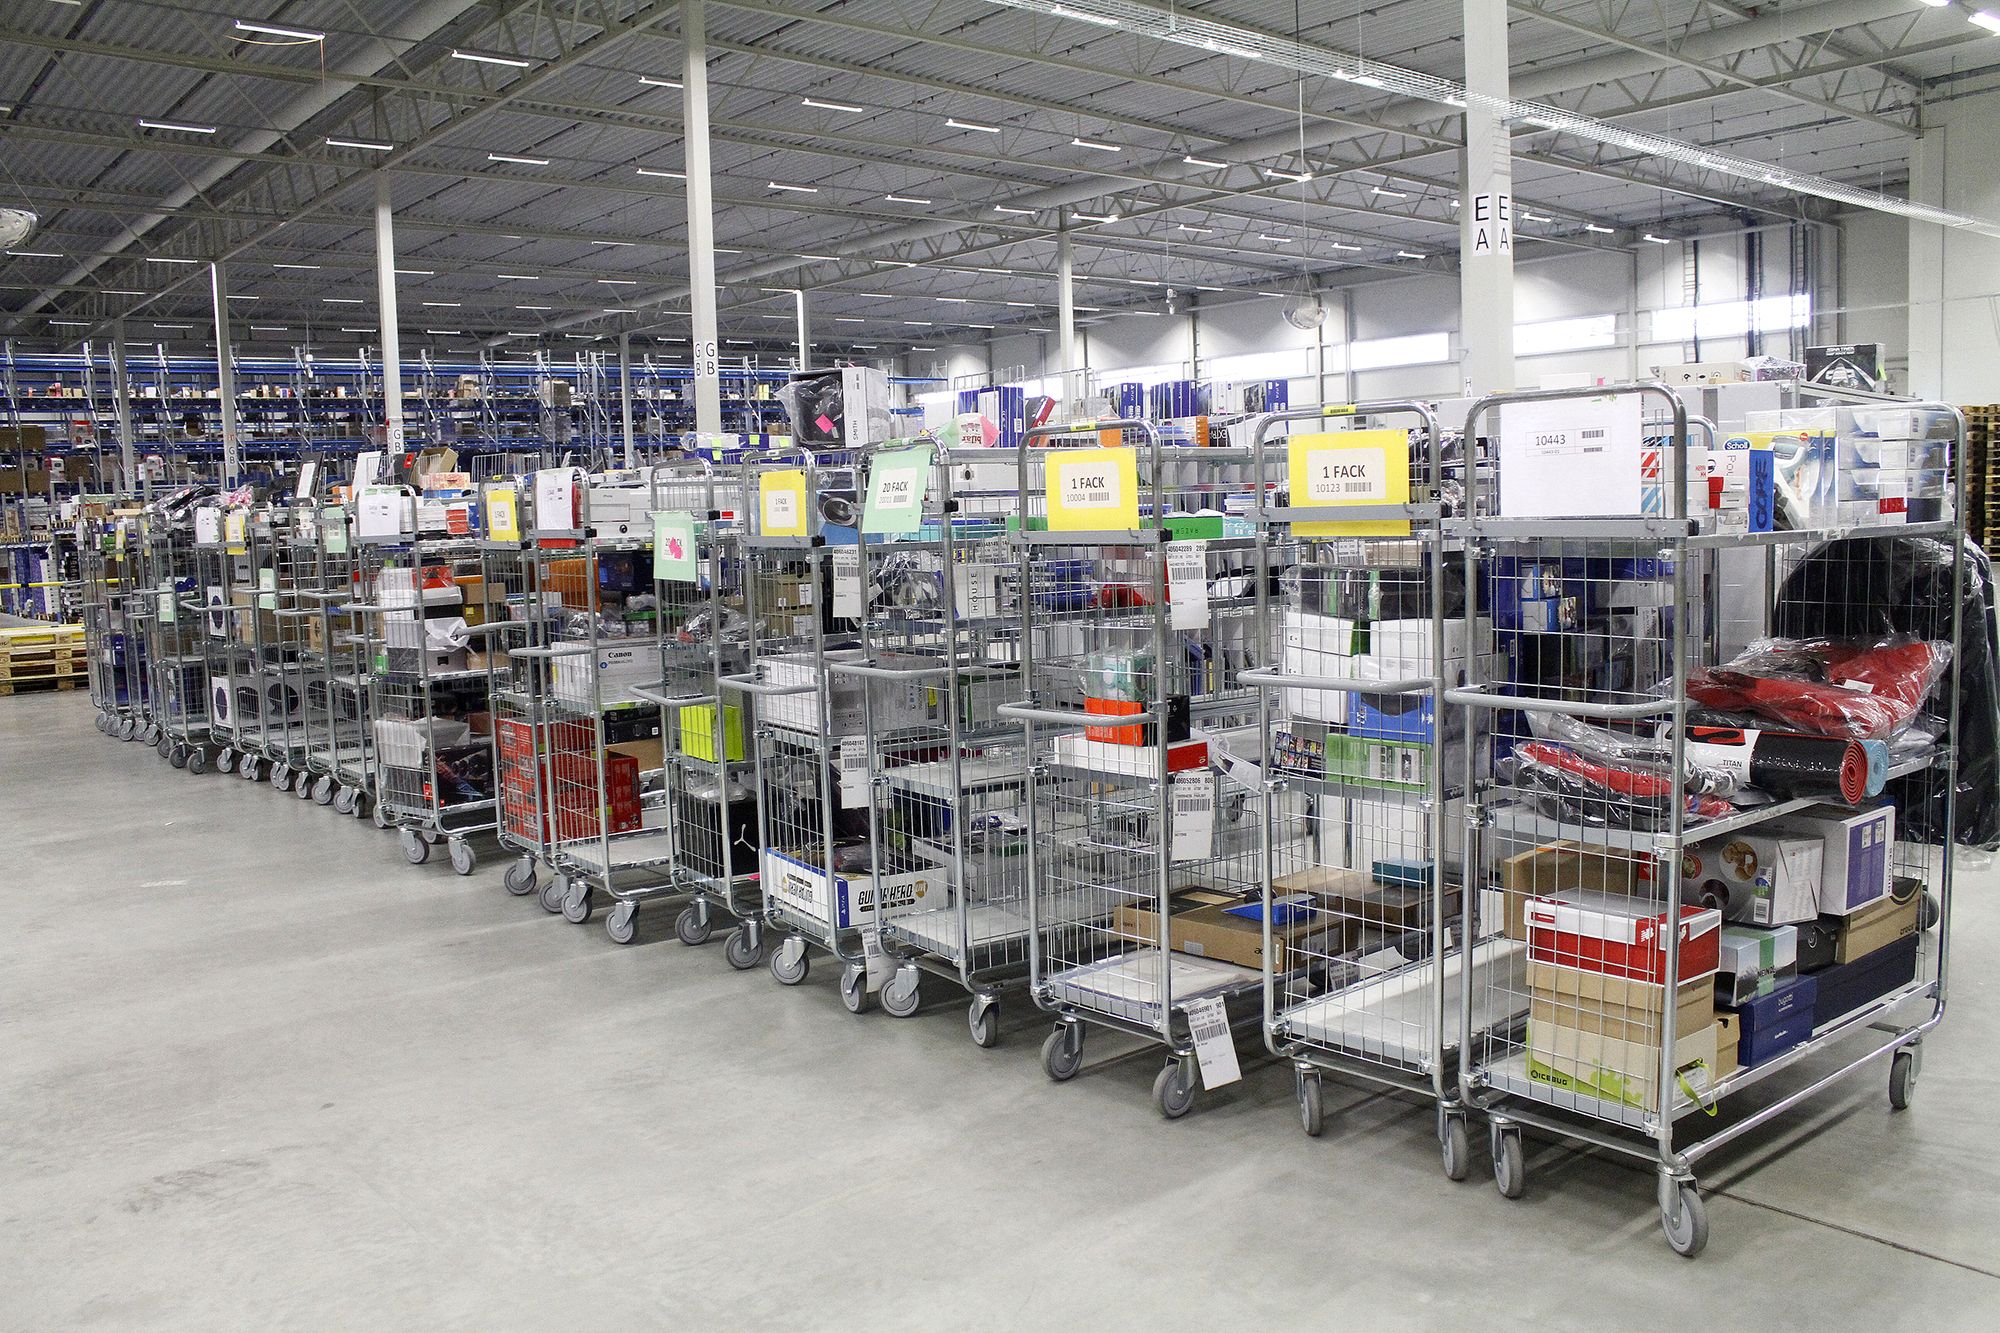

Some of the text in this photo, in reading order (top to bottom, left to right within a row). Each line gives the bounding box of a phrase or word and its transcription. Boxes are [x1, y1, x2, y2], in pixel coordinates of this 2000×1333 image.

[1475, 195, 1489, 222] E
[1499, 195, 1509, 221] E
[1475, 228, 1489, 251] A
[1500, 227, 1509, 250] A
[706, 342, 715, 357] G
[707, 361, 715, 375] B
[1535, 434, 1566, 446] 10443
[1727, 441, 1748, 450] Scholl
[1323, 465, 1366, 478] 1 FACK
[882, 481, 909, 493] 20 FACK
[1072, 476, 1105, 490] 1 FACK
[1315, 482, 1341, 493] 10123
[1066, 493, 1086, 502] 10004
[970, 572, 978, 611] HOUSE
[1722, 759, 1742, 767] TITAN
[890, 883, 913, 900] HERO
